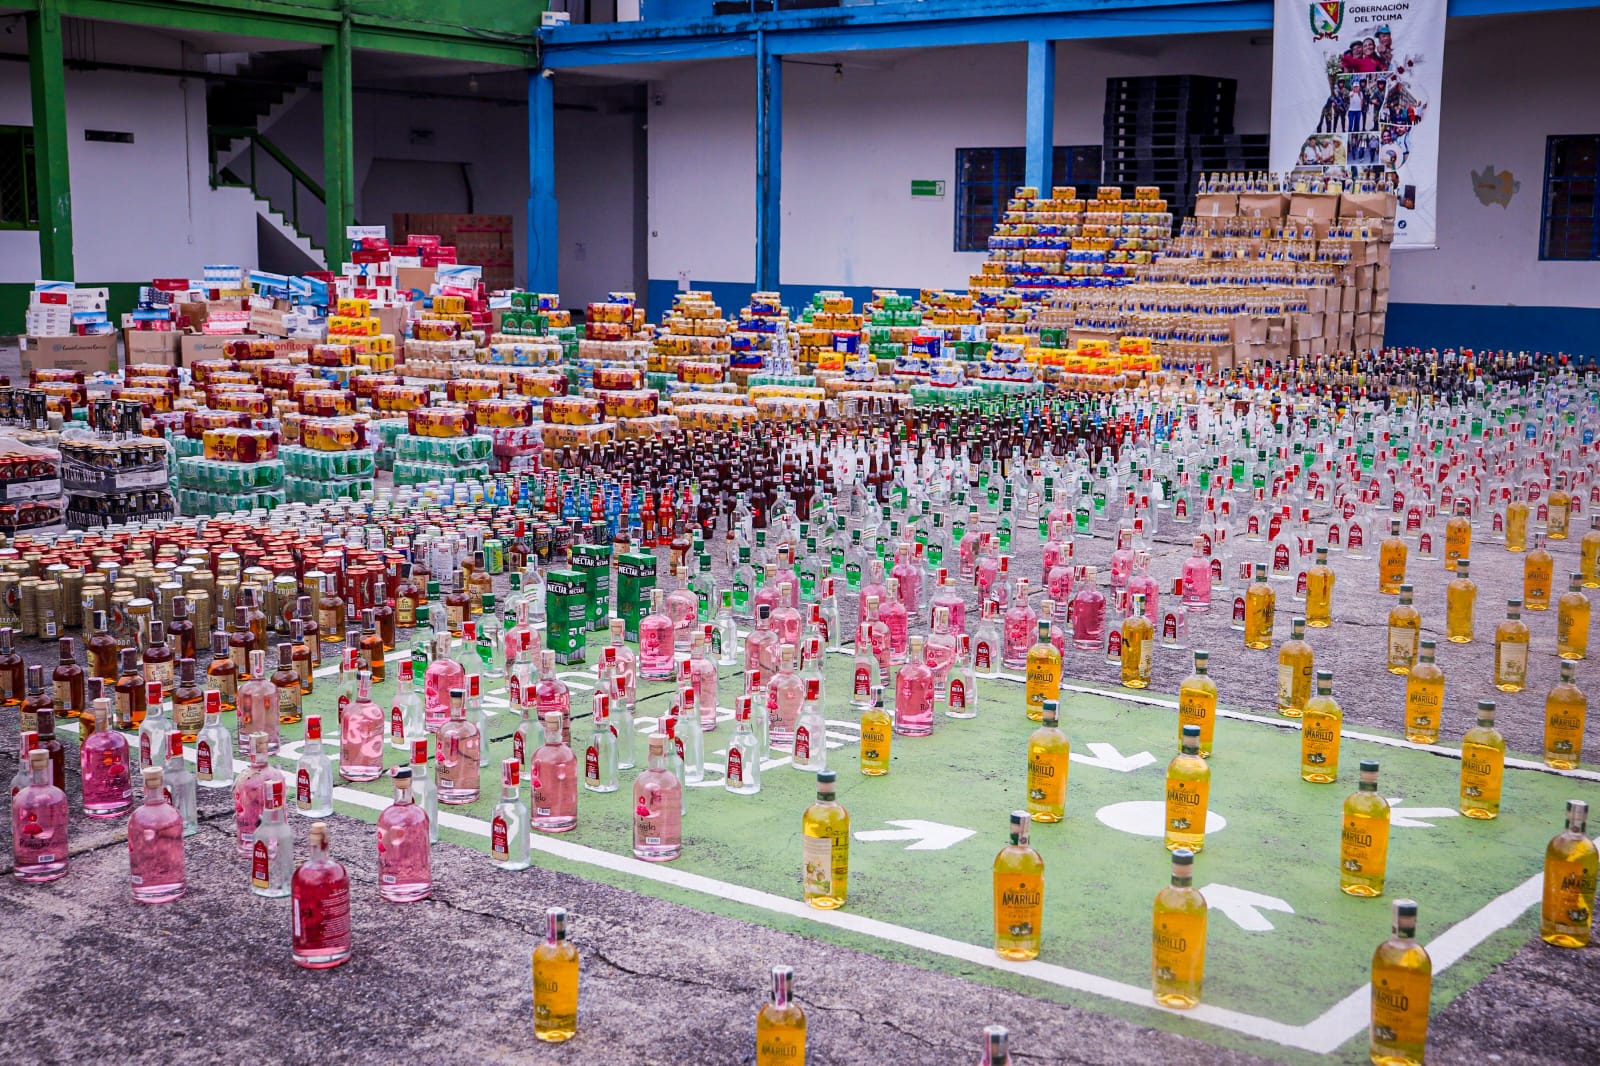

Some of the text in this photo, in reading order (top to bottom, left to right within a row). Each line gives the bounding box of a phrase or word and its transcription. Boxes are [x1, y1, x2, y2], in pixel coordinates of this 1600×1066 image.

[1371, 13, 1402, 22] TOLIMA
[573, 556, 595, 567] NECTAR
[618, 565, 639, 576] NECTAR
[547, 583, 568, 595] NECTAR
[1410, 693, 1438, 706] AMARILLO
[1550, 717, 1581, 730] AMARILLO
[1304, 729, 1334, 742] AMARILLO
[1167, 790, 1200, 806] AMARILLO
[1002, 891, 1040, 906] AMARILLO
[762, 1045, 797, 1057] AMARILLO
